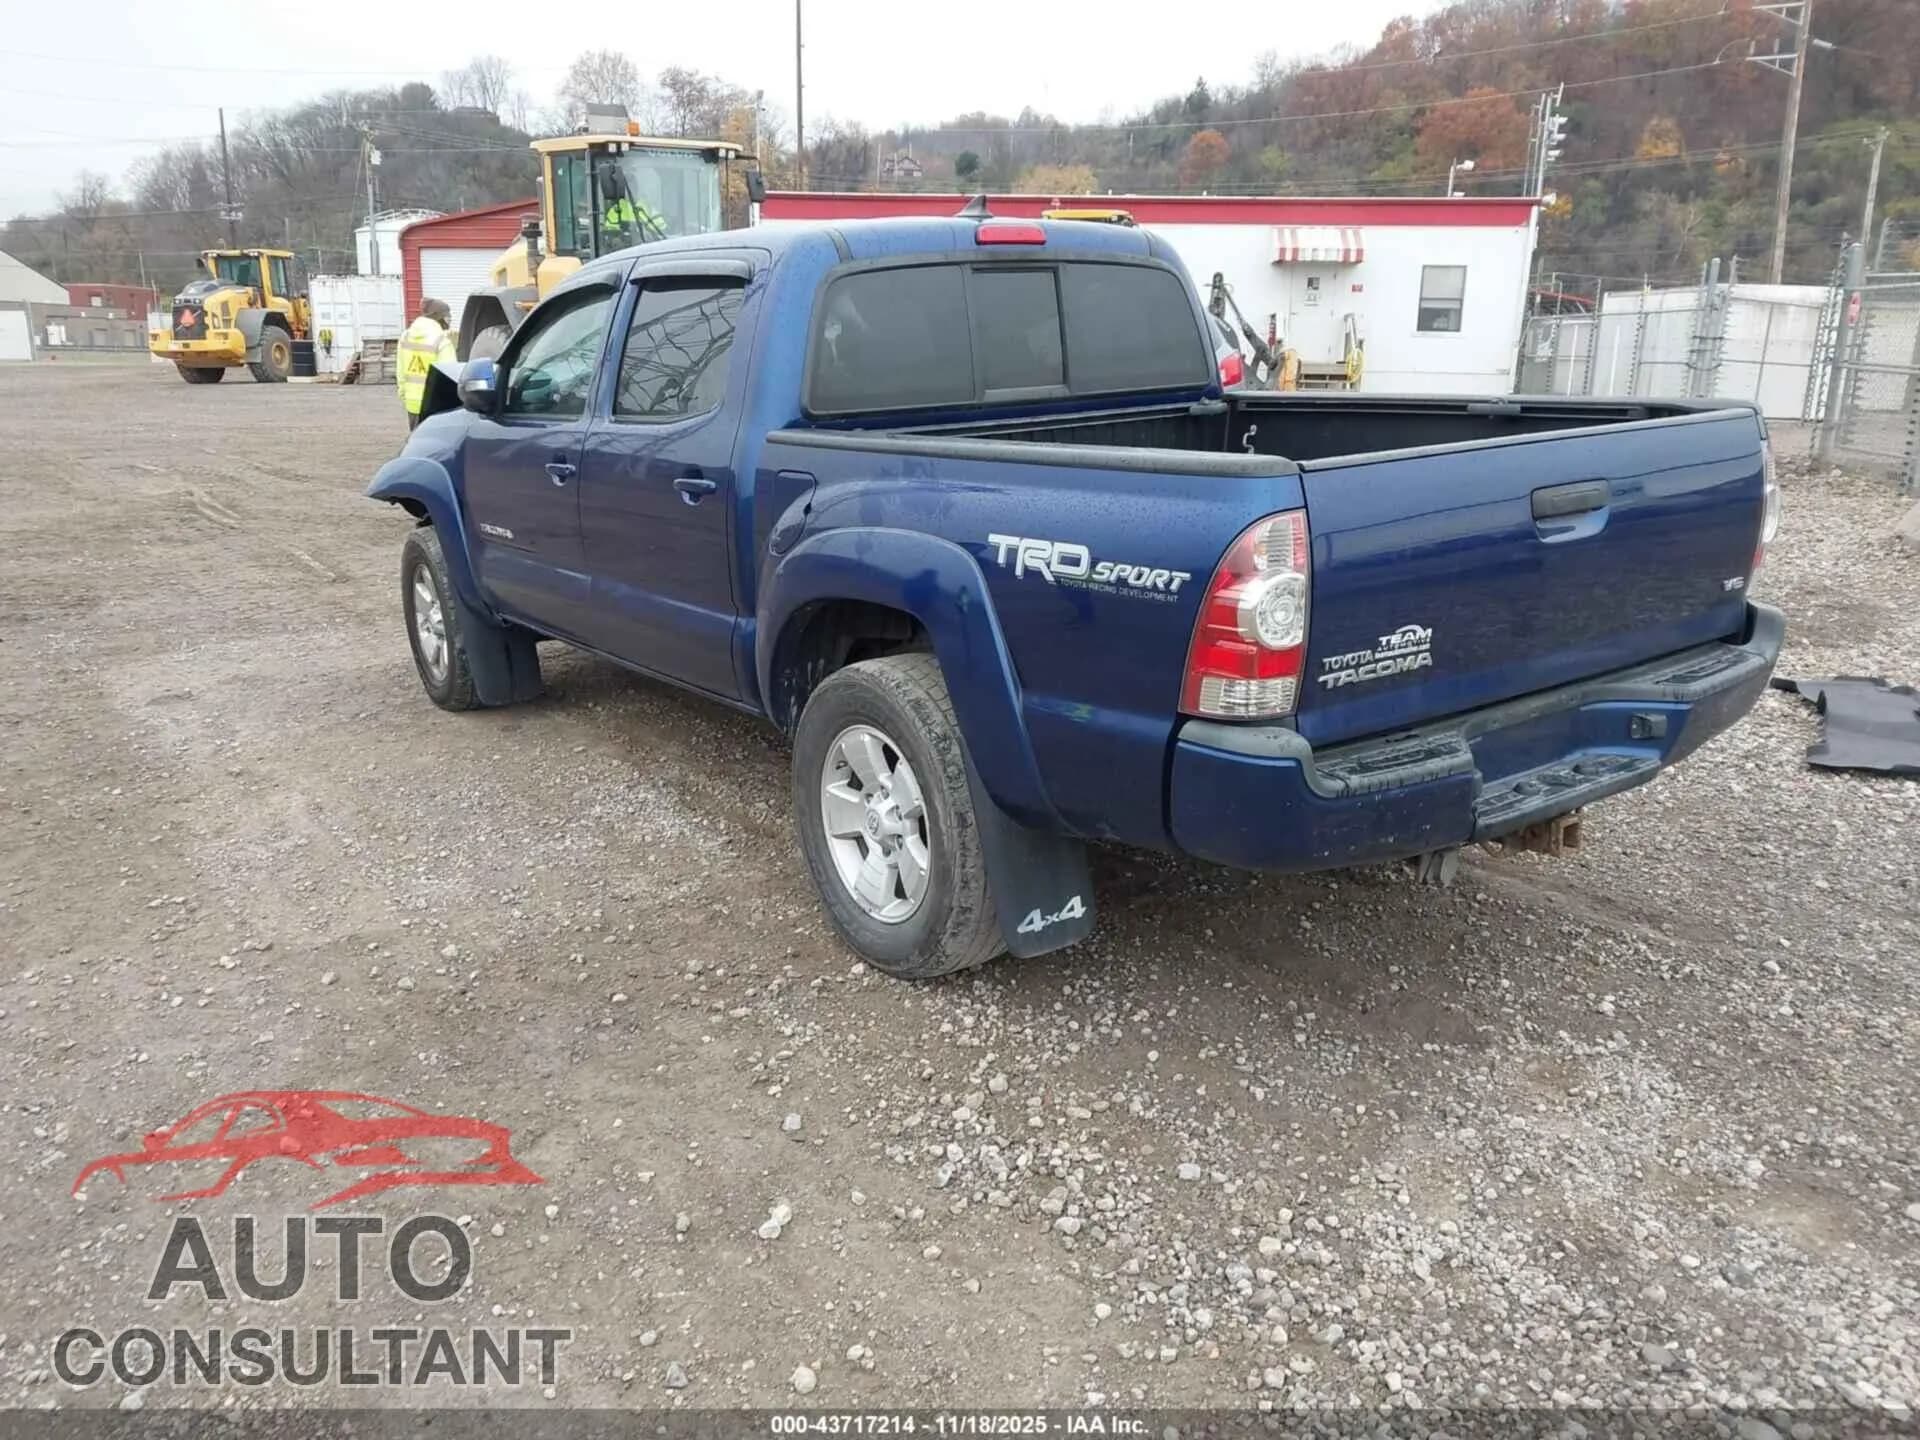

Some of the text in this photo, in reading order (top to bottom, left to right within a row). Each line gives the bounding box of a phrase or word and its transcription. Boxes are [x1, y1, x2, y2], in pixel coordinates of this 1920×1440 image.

[987, 533, 1192, 593] TRD SPORT
[1118, 587, 1179, 603] DEVELOPMENT
[1378, 627, 1433, 647] TEAM
[1317, 652, 1433, 689] TACOMA
[1322, 649, 1374, 671] TOYOTA
